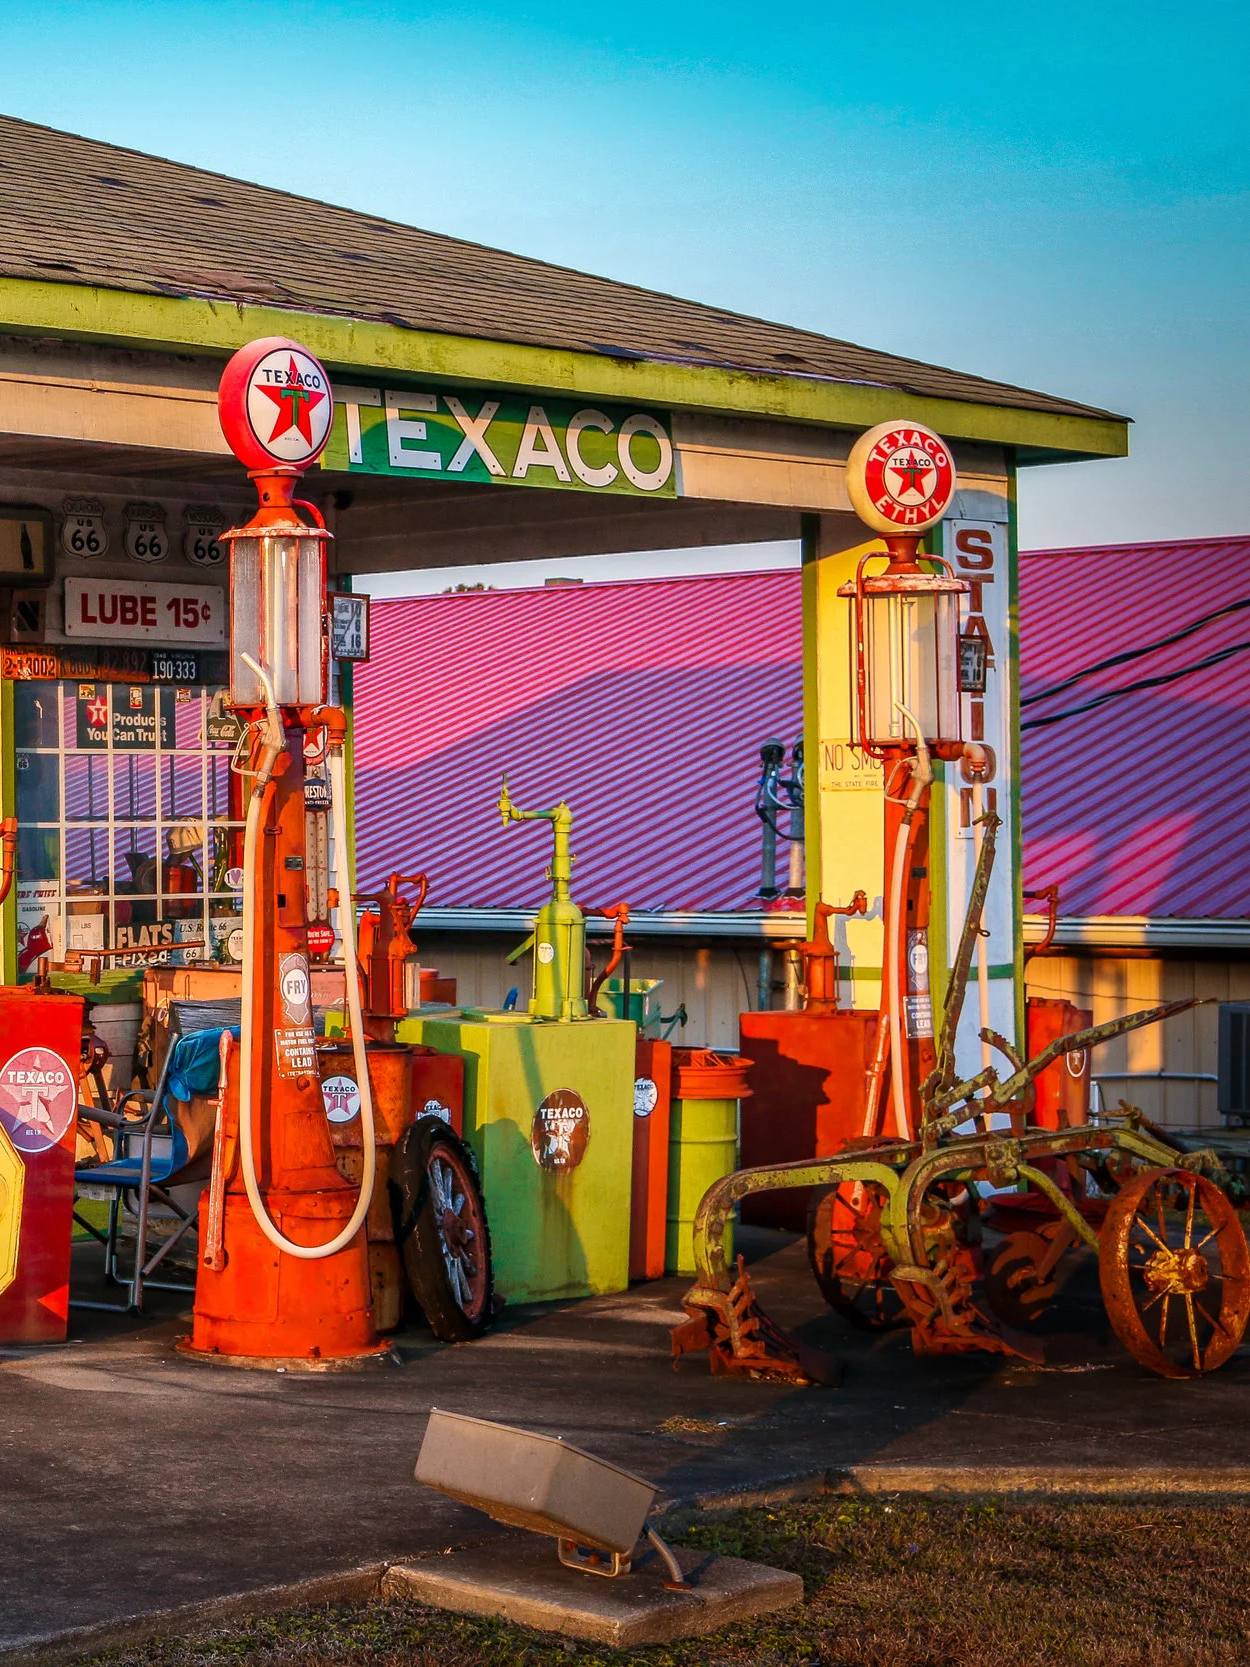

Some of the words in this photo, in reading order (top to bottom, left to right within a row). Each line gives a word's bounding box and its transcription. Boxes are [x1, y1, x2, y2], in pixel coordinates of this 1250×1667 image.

[262, 369, 321, 389] TEXACO
[330, 384, 674, 492] TEXACO
[868, 431, 948, 468] TEXACO
[892, 458, 931, 467] TEXACO
[875, 494, 944, 524] ETHYL
[76, 518, 93, 527] US
[139, 524, 155, 532] US
[198, 528, 214, 536] US
[71, 529, 100, 552] 66
[134, 535, 162, 557] 66
[193, 539, 221, 561] 66
[81, 592, 158, 628] LUBE
[112, 729, 135, 741] Can
[824, 744, 844, 771] NO
[845, 780, 862, 788] STATE
[218, 921, 227, 931] 66
[116, 923, 173, 949] FLATS
[185, 949, 197, 958] 66
[285, 979, 307, 995] FRY
[284, 1047, 315, 1057] CONTAINS
[291, 1057, 313, 1068] LEAD
[7, 1070, 65, 1084] TEXACO
[323, 1085, 356, 1093] TEXACO
[540, 1107, 584, 1120] TEXACO
